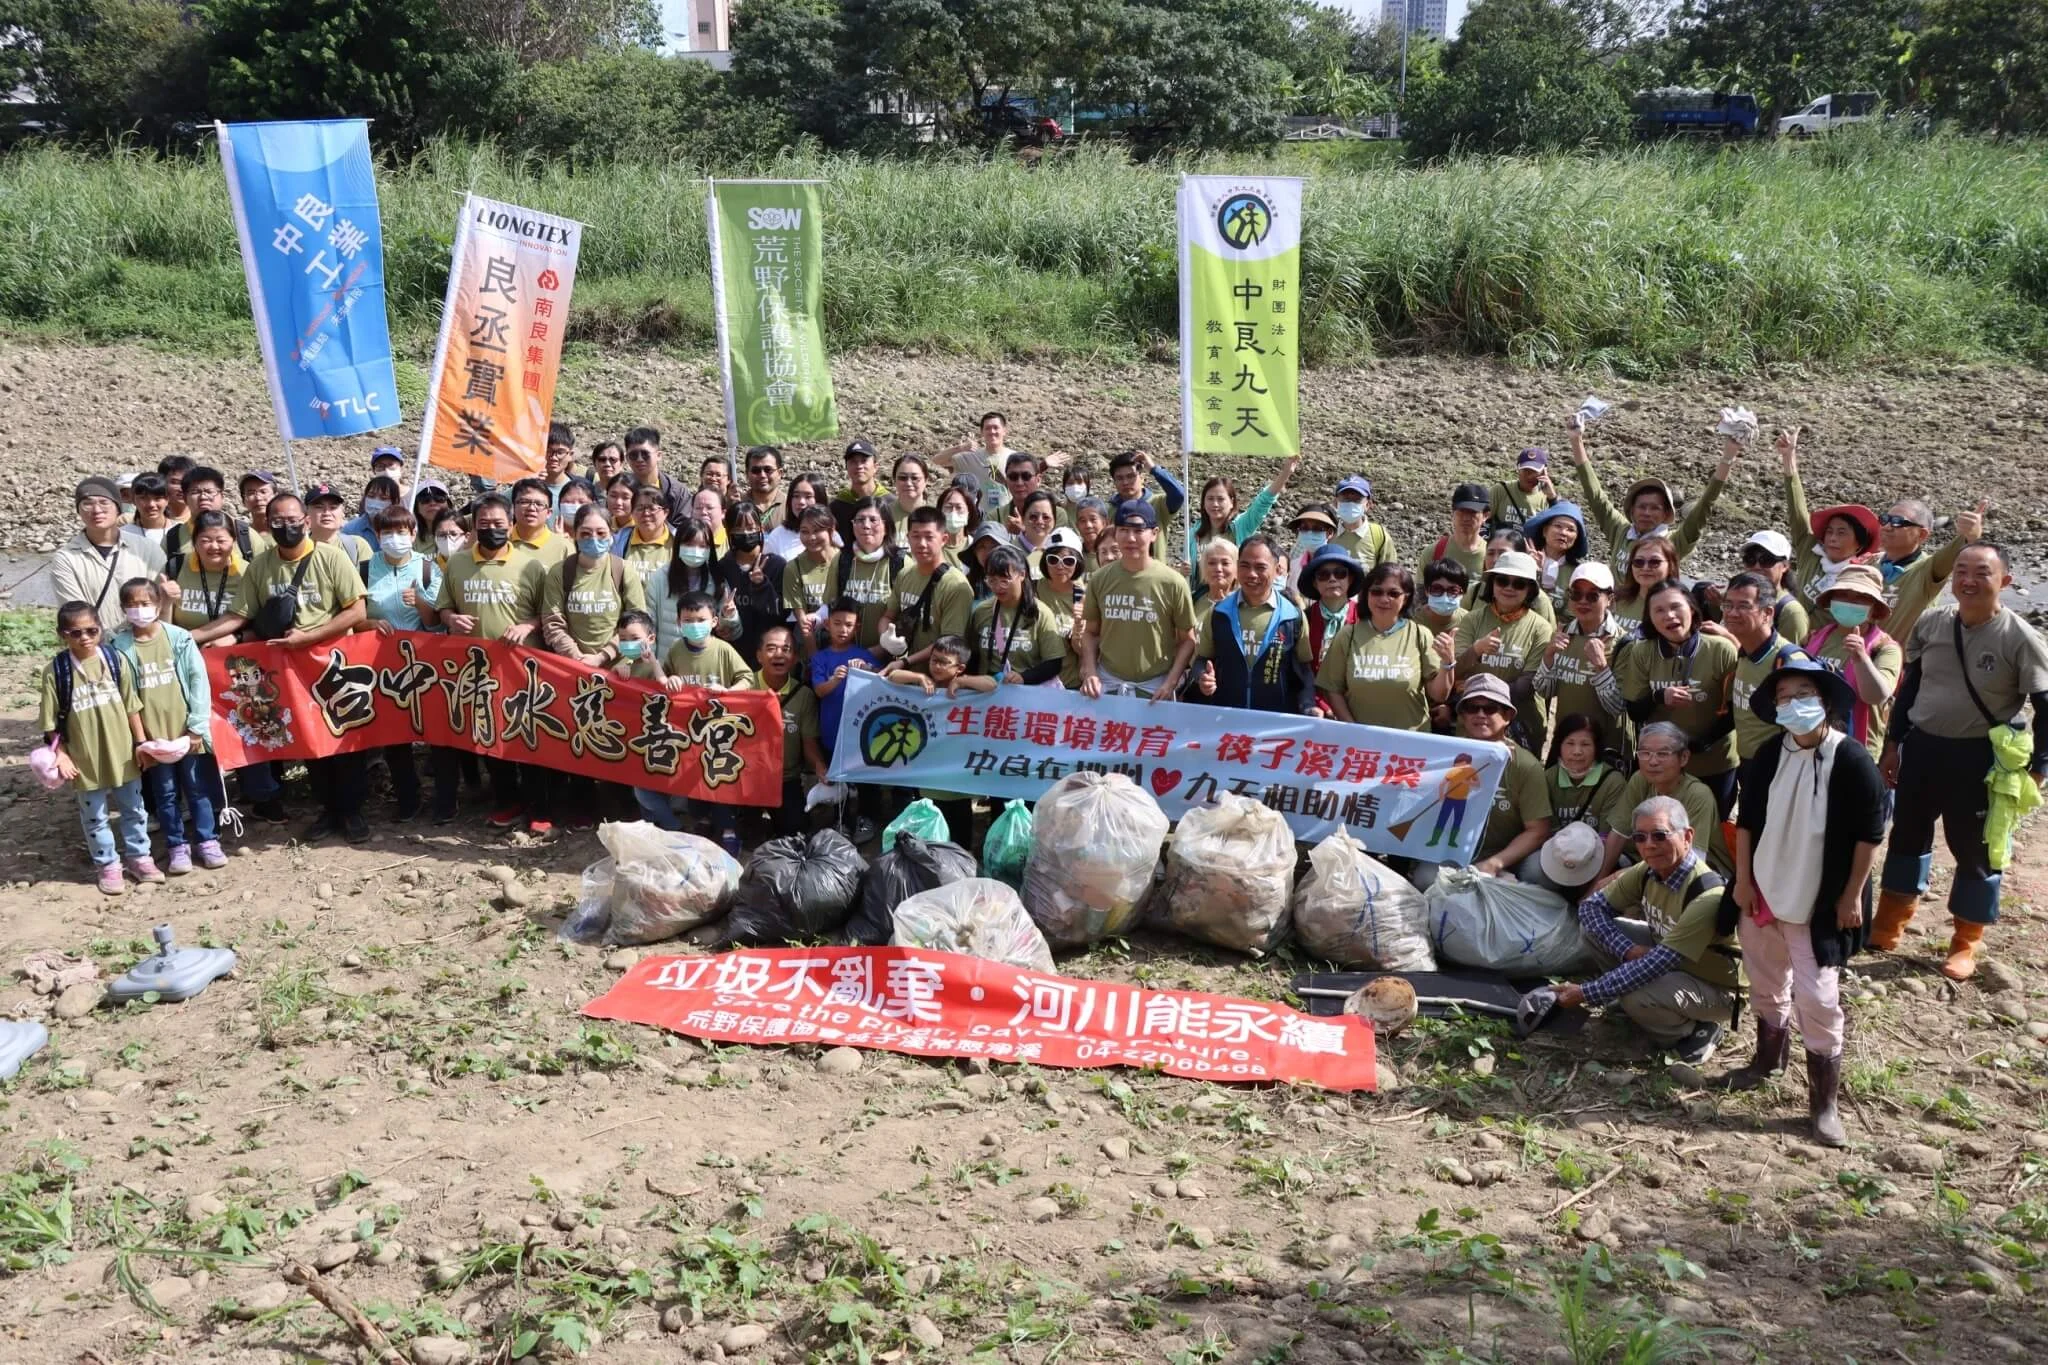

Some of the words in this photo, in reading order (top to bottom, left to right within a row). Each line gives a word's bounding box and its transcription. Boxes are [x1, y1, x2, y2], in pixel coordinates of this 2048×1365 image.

[271, 193, 335, 257] 中良
[476, 208, 572, 246] LIONGTEX
[747, 207, 802, 231] SOW
[305, 218, 369, 290] 工業
[520, 240, 568, 257] INNOVATION
[752, 235, 797, 407] 荒野保護協會
[1272, 279, 1287, 357] 財團法人
[522, 297, 554, 393] 南良集團
[453, 256, 518, 457] 良丞實業
[1231, 278, 1268, 438] 中良九天
[1206, 319, 1223, 437] 教育基金會
[334, 392, 380, 417] TLC
[463, 579, 494, 592] RIVER
[181, 601, 208, 615] CLEA
[463, 592, 489, 603] CLEAN
[567, 602, 593, 613] CLEAN
[594, 601, 606, 613] UP
[1105, 594, 1135, 607] RIVER
[1105, 607, 1131, 620] CLEAN
[1131, 609, 1144, 621] UP
[1353, 655, 1389, 666] RIVER
[1481, 653, 1499, 667] EAN
[1354, 667, 1385, 680] CLEAN
[1386, 667, 1401, 679] UP
[1556, 669, 1575, 684] EAN
[312, 640, 755, 788] 台中清水慈善宮
[799, 1003, 850, 1024] the
